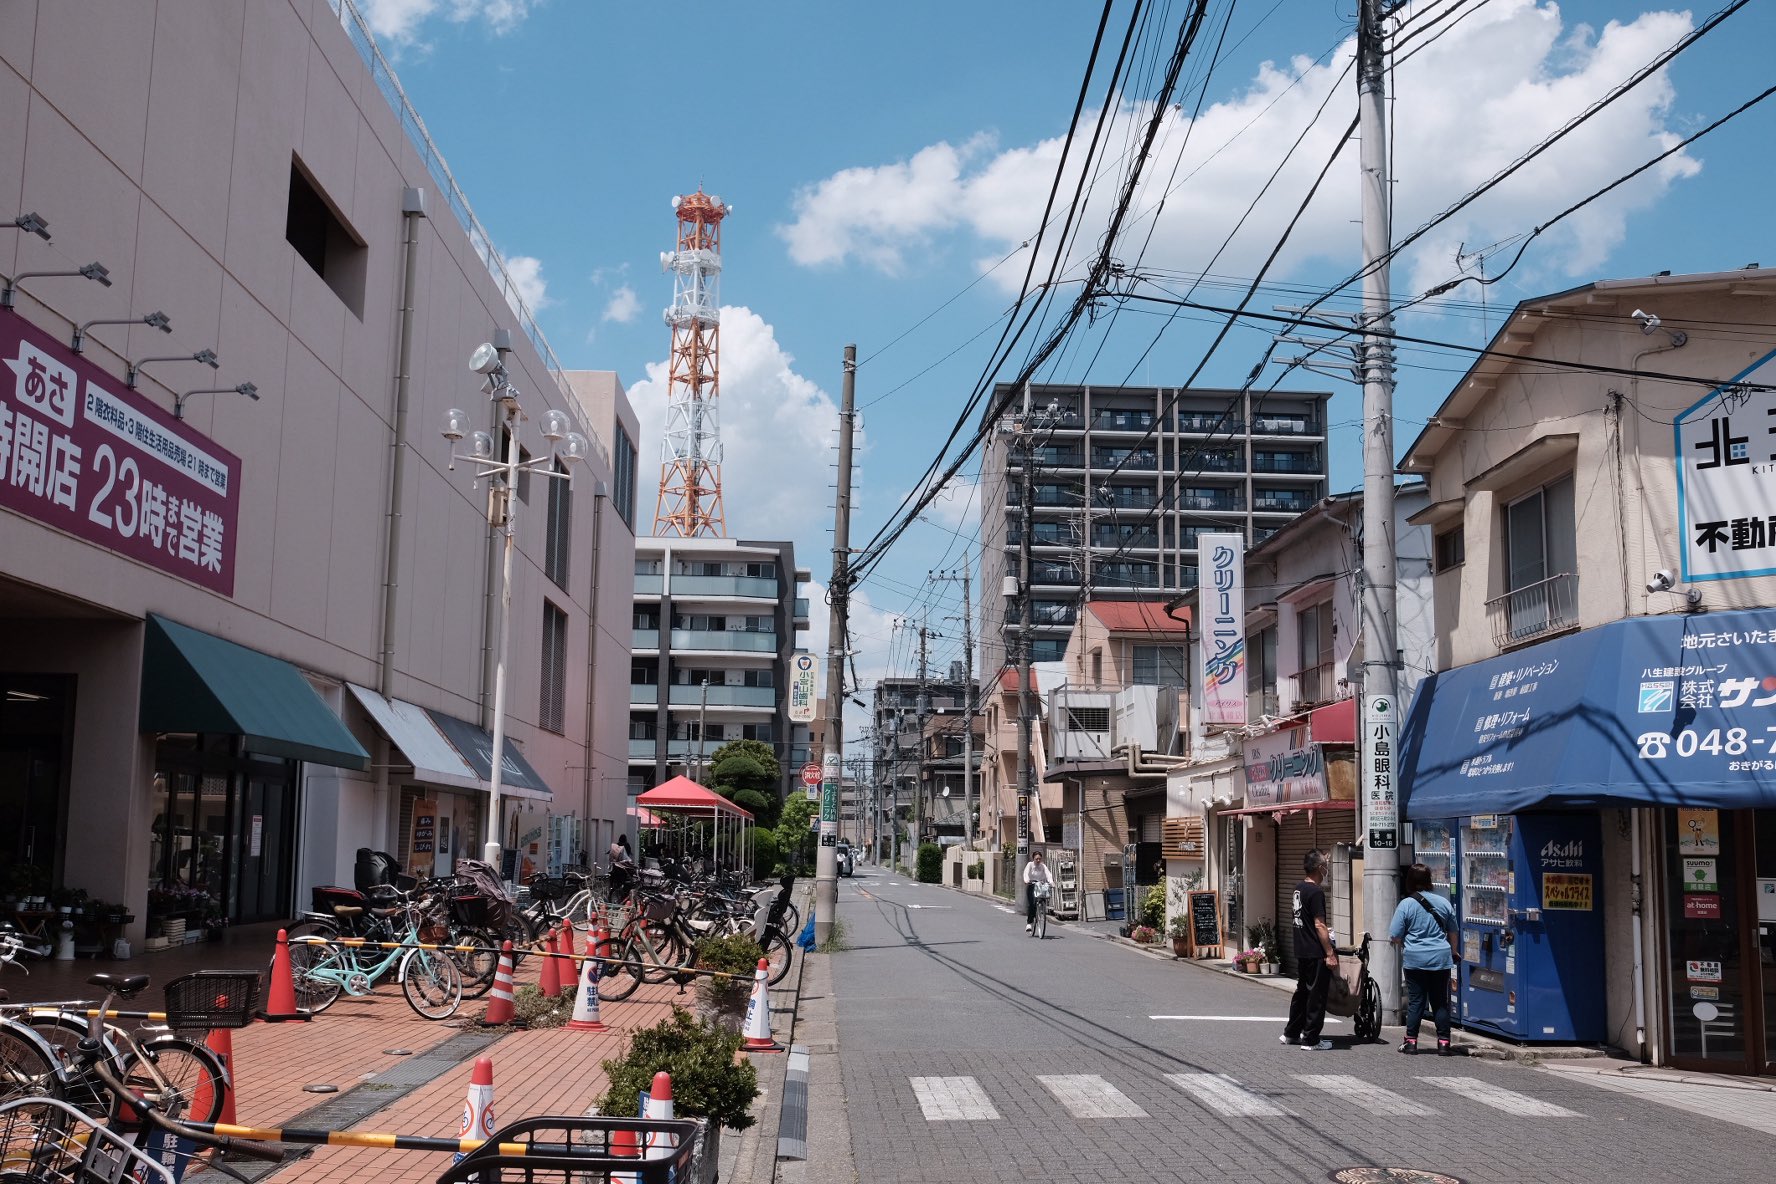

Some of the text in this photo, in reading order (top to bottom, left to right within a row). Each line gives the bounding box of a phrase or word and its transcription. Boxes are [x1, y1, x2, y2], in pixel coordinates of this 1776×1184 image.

[25, 355, 69, 417] あさ
[1212, 546, 1238, 685] クリーニング
[799, 671, 810, 707] 小宮山歯科
[1270, 744, 1318, 783] クリーニング
[1374, 724, 1390, 790] 小島眼科
[1728, 760, 1776, 772] おきがる
[823, 788, 831, 821] クリニック
[1540, 839, 1583, 857] Asahi
[1541, 858, 1583, 868] アサヒ飲料
[1686, 901, 1718, 909] at home
